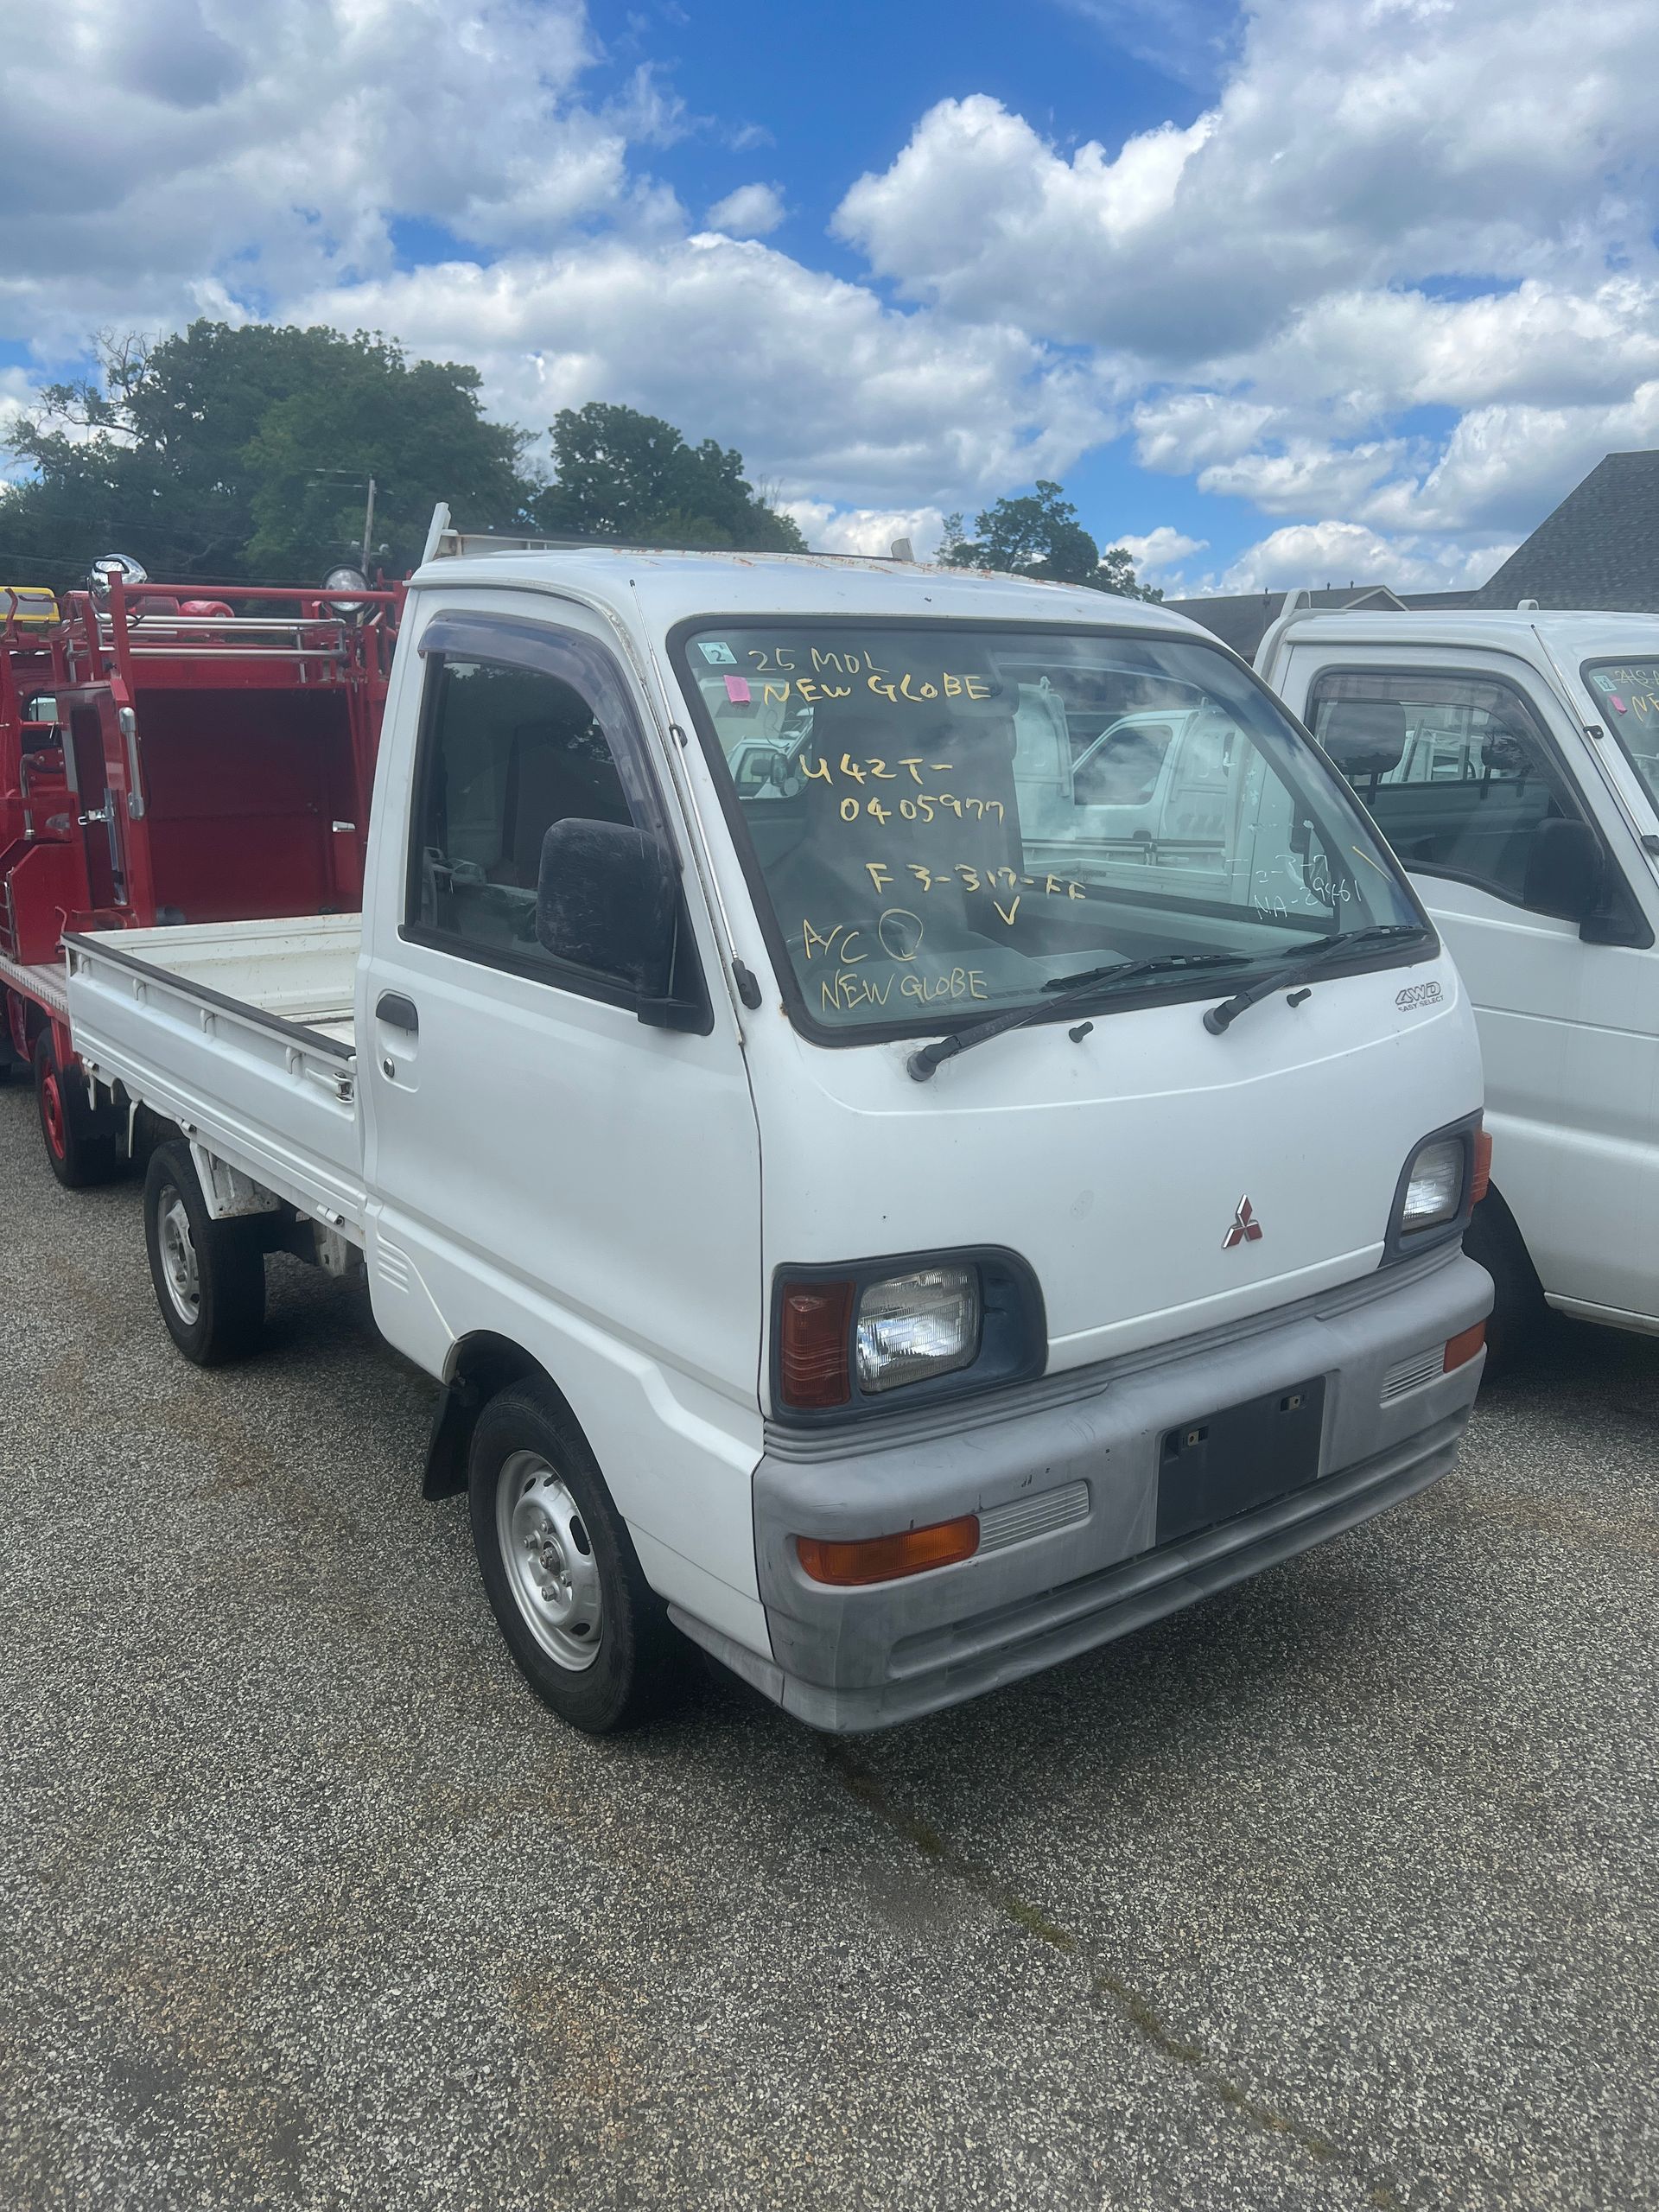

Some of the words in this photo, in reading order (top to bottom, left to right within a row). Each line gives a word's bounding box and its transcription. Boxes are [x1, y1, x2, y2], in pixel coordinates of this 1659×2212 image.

[748, 647, 796, 671] 25
[867, 671, 992, 702] GLOBE
[840, 793, 1004, 825] 0405977
[822, 969, 896, 1013] NEW
[900, 967, 988, 1003] GLOBE
[1395, 981, 1441, 1005] 4WD
[1398, 1002, 1418, 1012] EASY
[1419, 995, 1444, 1007] SELECT
